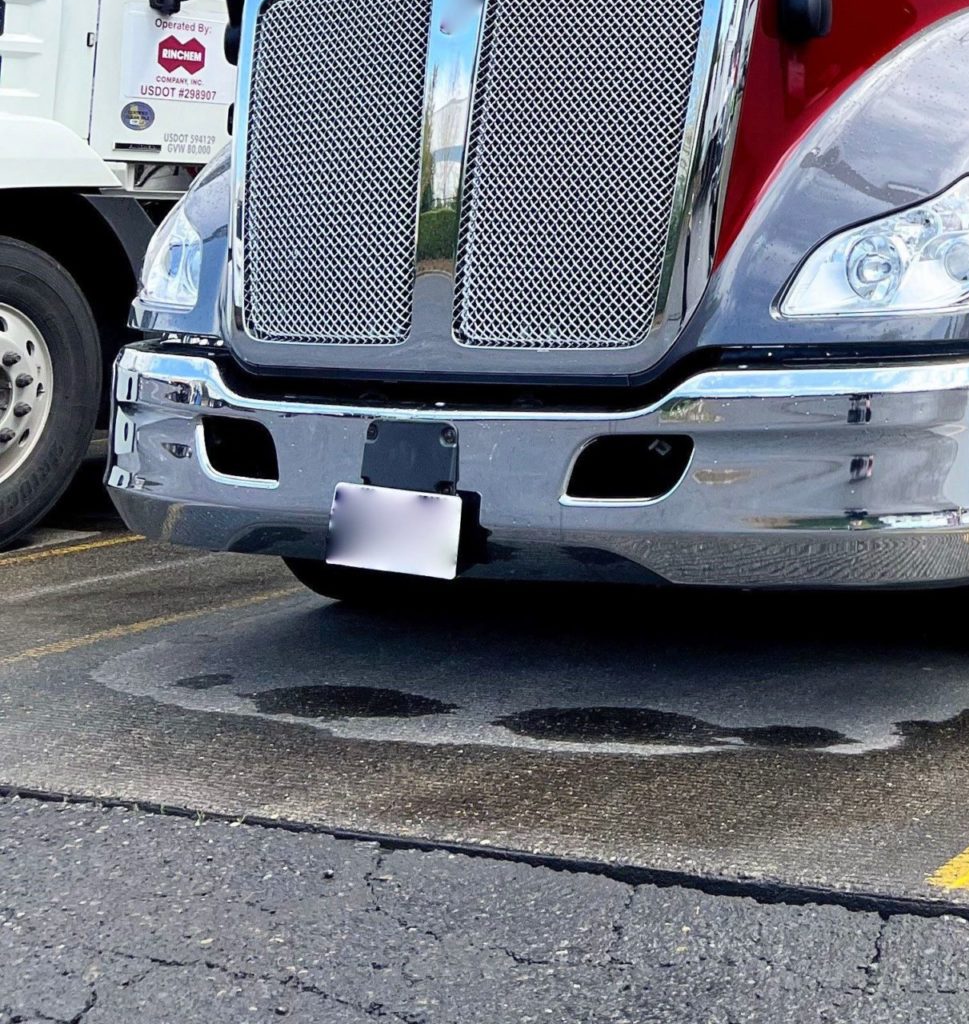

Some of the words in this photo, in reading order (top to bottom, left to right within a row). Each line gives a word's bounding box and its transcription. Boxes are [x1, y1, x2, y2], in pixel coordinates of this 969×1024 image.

[155, 18, 196, 33] Operated
[198, 22, 212, 35] By:
[161, 48, 202, 62] RINCHEM
[156, 75, 189, 86] COMPANY,
[140, 85, 176, 98] USDOT
[178, 88, 217, 101] #298907
[163, 132, 189, 143] USDOT
[167, 143, 185, 154] GVW
